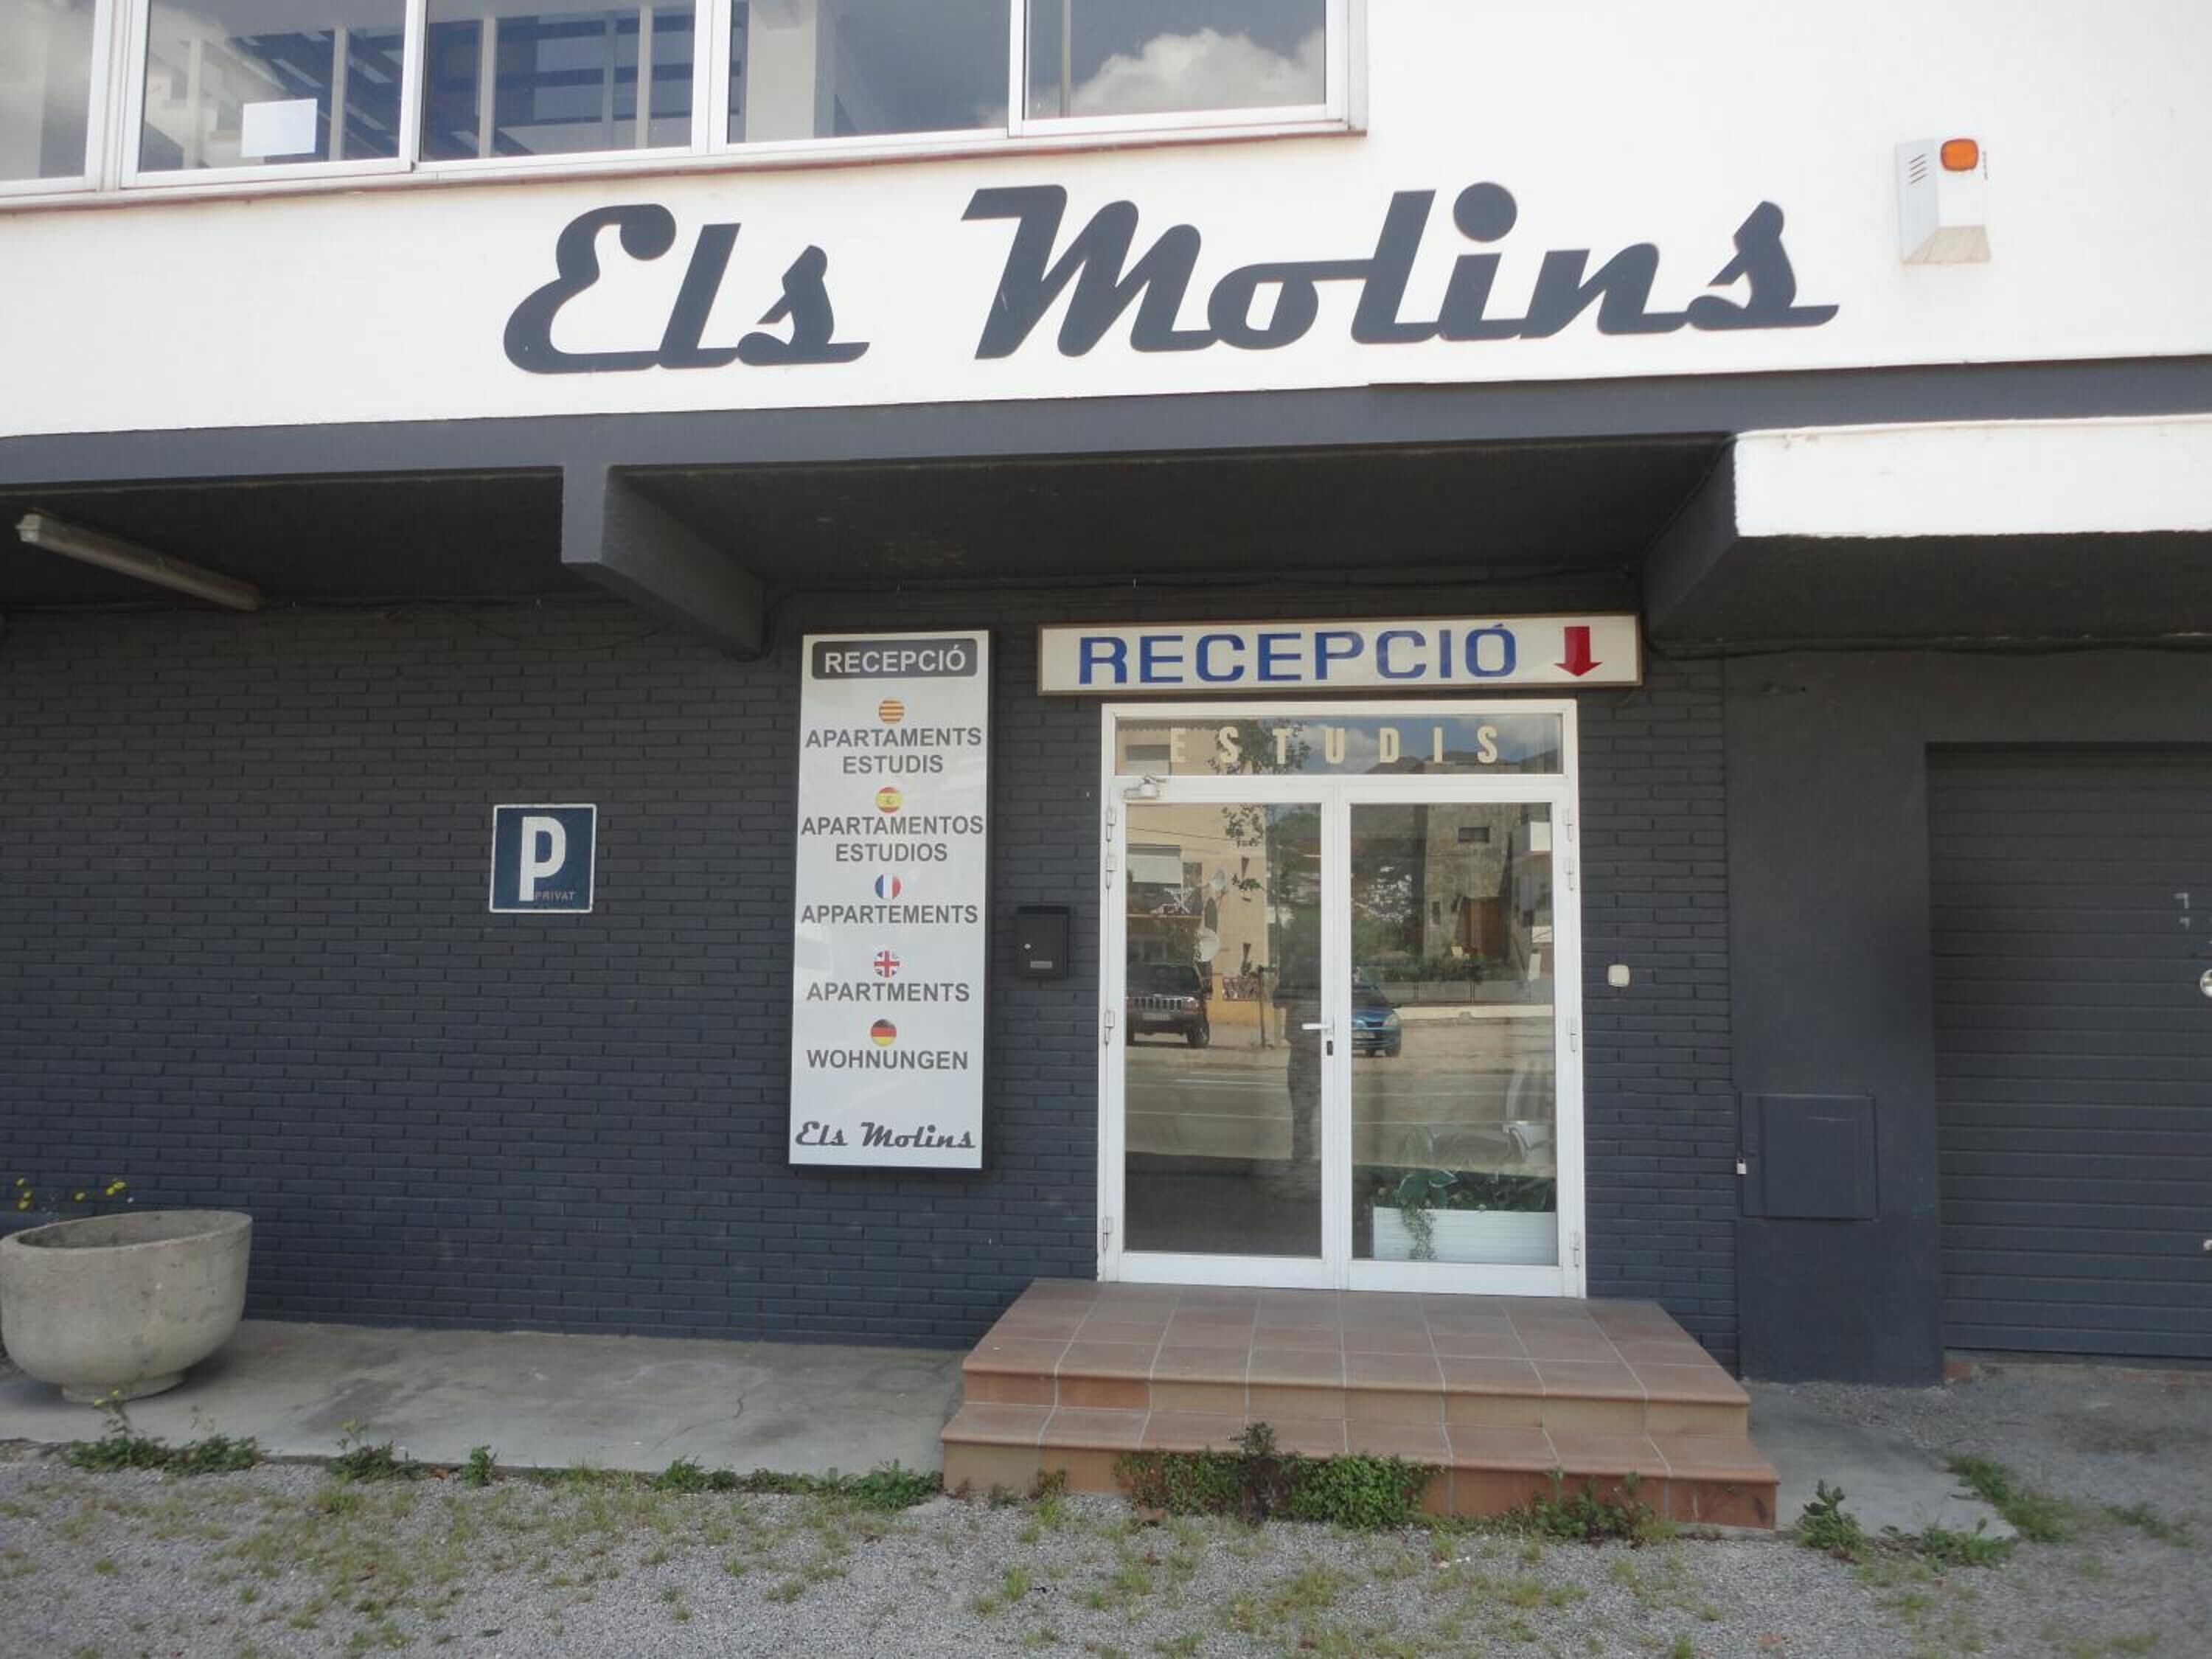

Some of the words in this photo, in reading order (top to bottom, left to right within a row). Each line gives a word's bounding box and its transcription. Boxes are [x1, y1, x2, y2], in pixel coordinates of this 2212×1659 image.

[504, 204, 870, 375] Els
[961, 181, 1840, 360] Molins
[824, 644, 967, 673] RECEPCIÓ
[1078, 623, 1517, 686] RECEPCIÓ
[805, 726, 982, 748] APARTAMENTS
[1169, 725, 1498, 765] ESTUDIS
[843, 754, 944, 774] ESTUDIS
[800, 815, 984, 835] APARTAMENTOS
[518, 815, 567, 902] P
[835, 843, 948, 862] ESTUDIOS
[535, 891, 577, 901] PRIVAT
[801, 905, 978, 924] APPARTEMENTS
[806, 982, 970, 1002] APARTMENTS
[806, 1049, 968, 1071] WOHNUNGEN
[796, 1121, 849, 1147] Els
[860, 1121, 976, 1149] Molins
